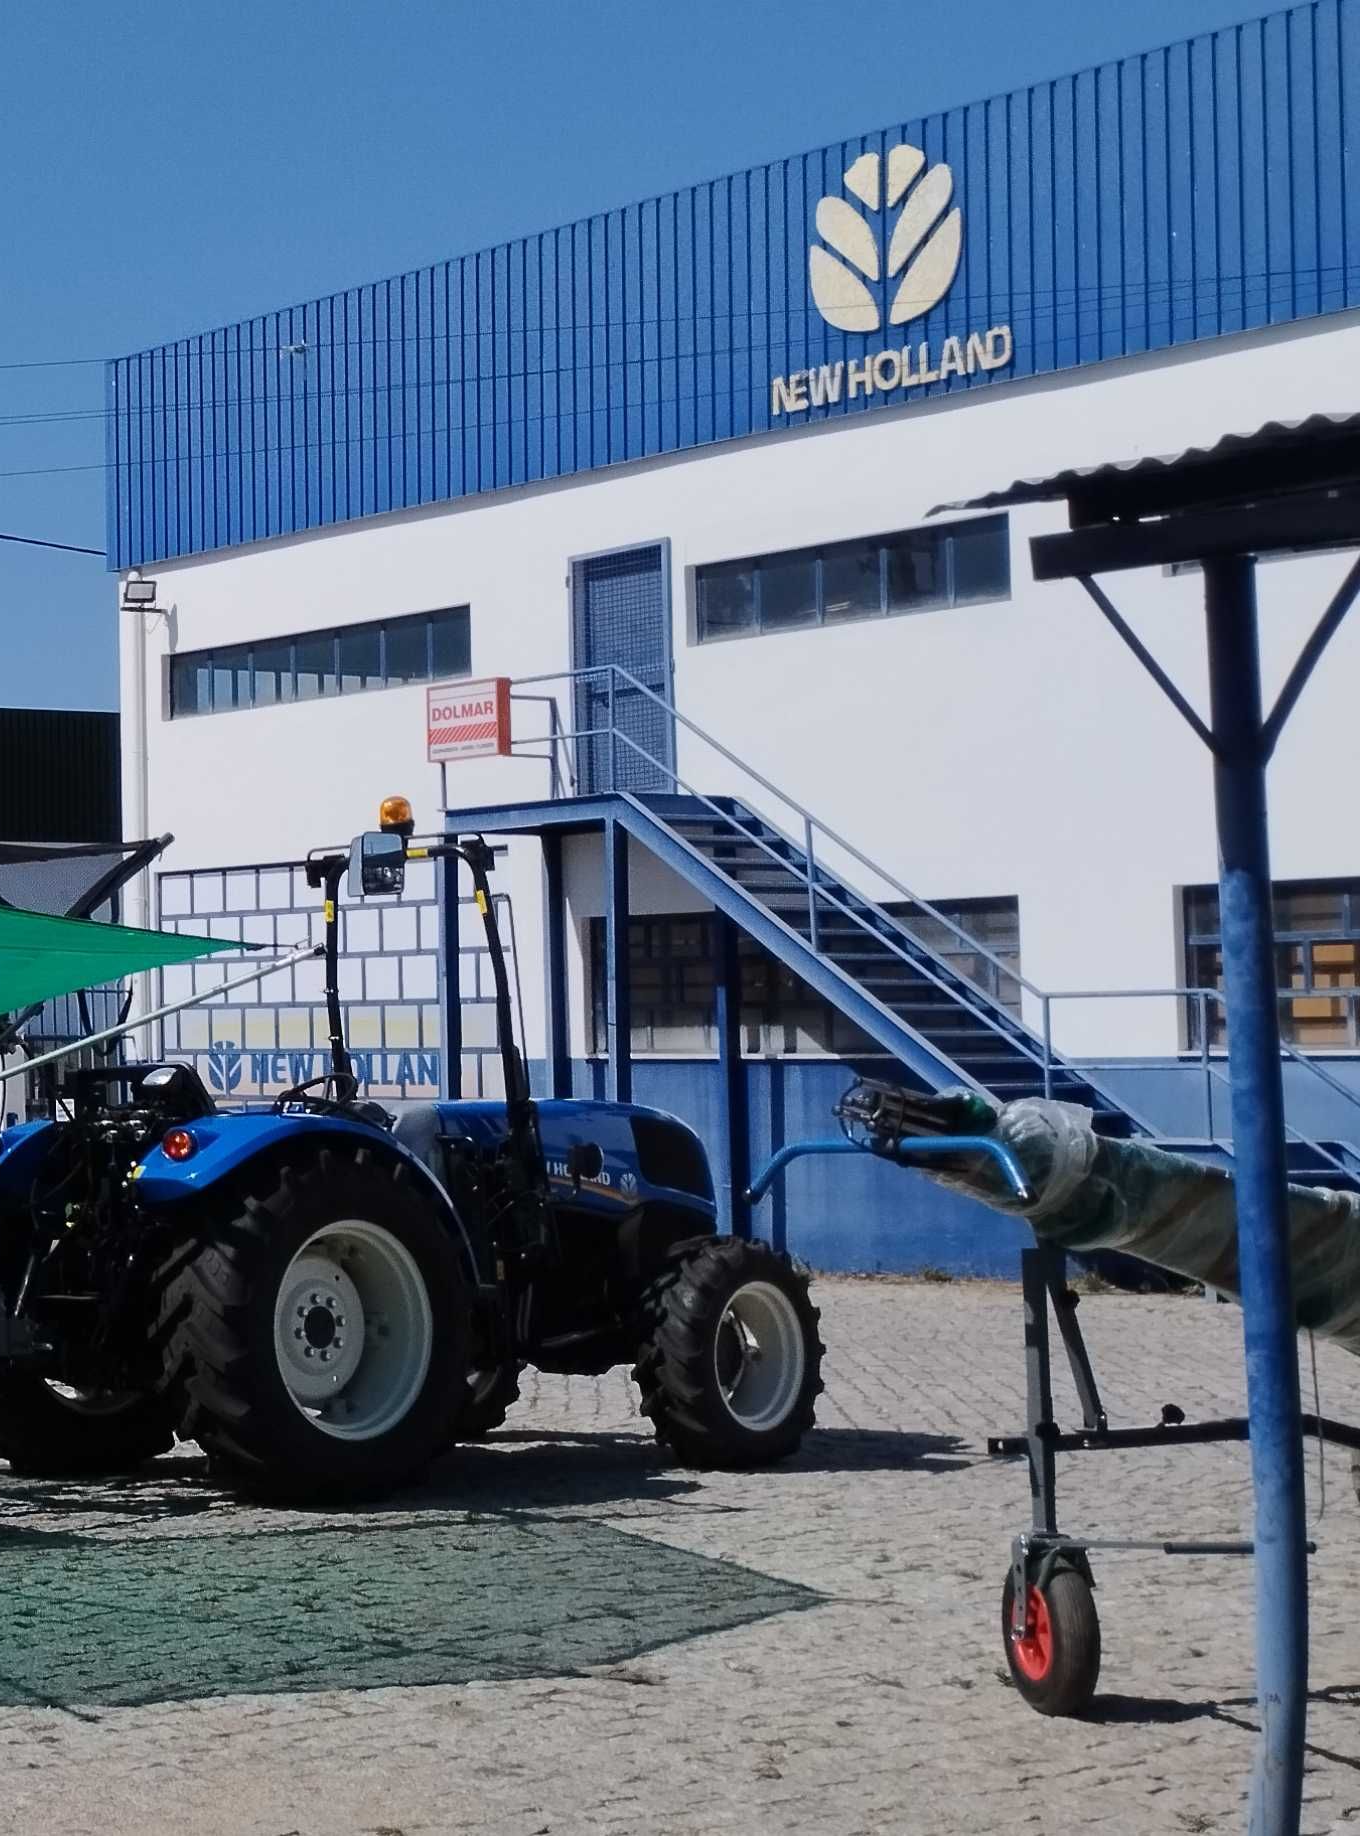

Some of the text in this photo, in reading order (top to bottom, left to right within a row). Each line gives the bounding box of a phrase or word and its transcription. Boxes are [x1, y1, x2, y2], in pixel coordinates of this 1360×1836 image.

[772, 325, 1012, 416] NEW HOLLAND
[431, 700, 494, 722] DOLMAR
[251, 1051, 314, 1087] NEW
